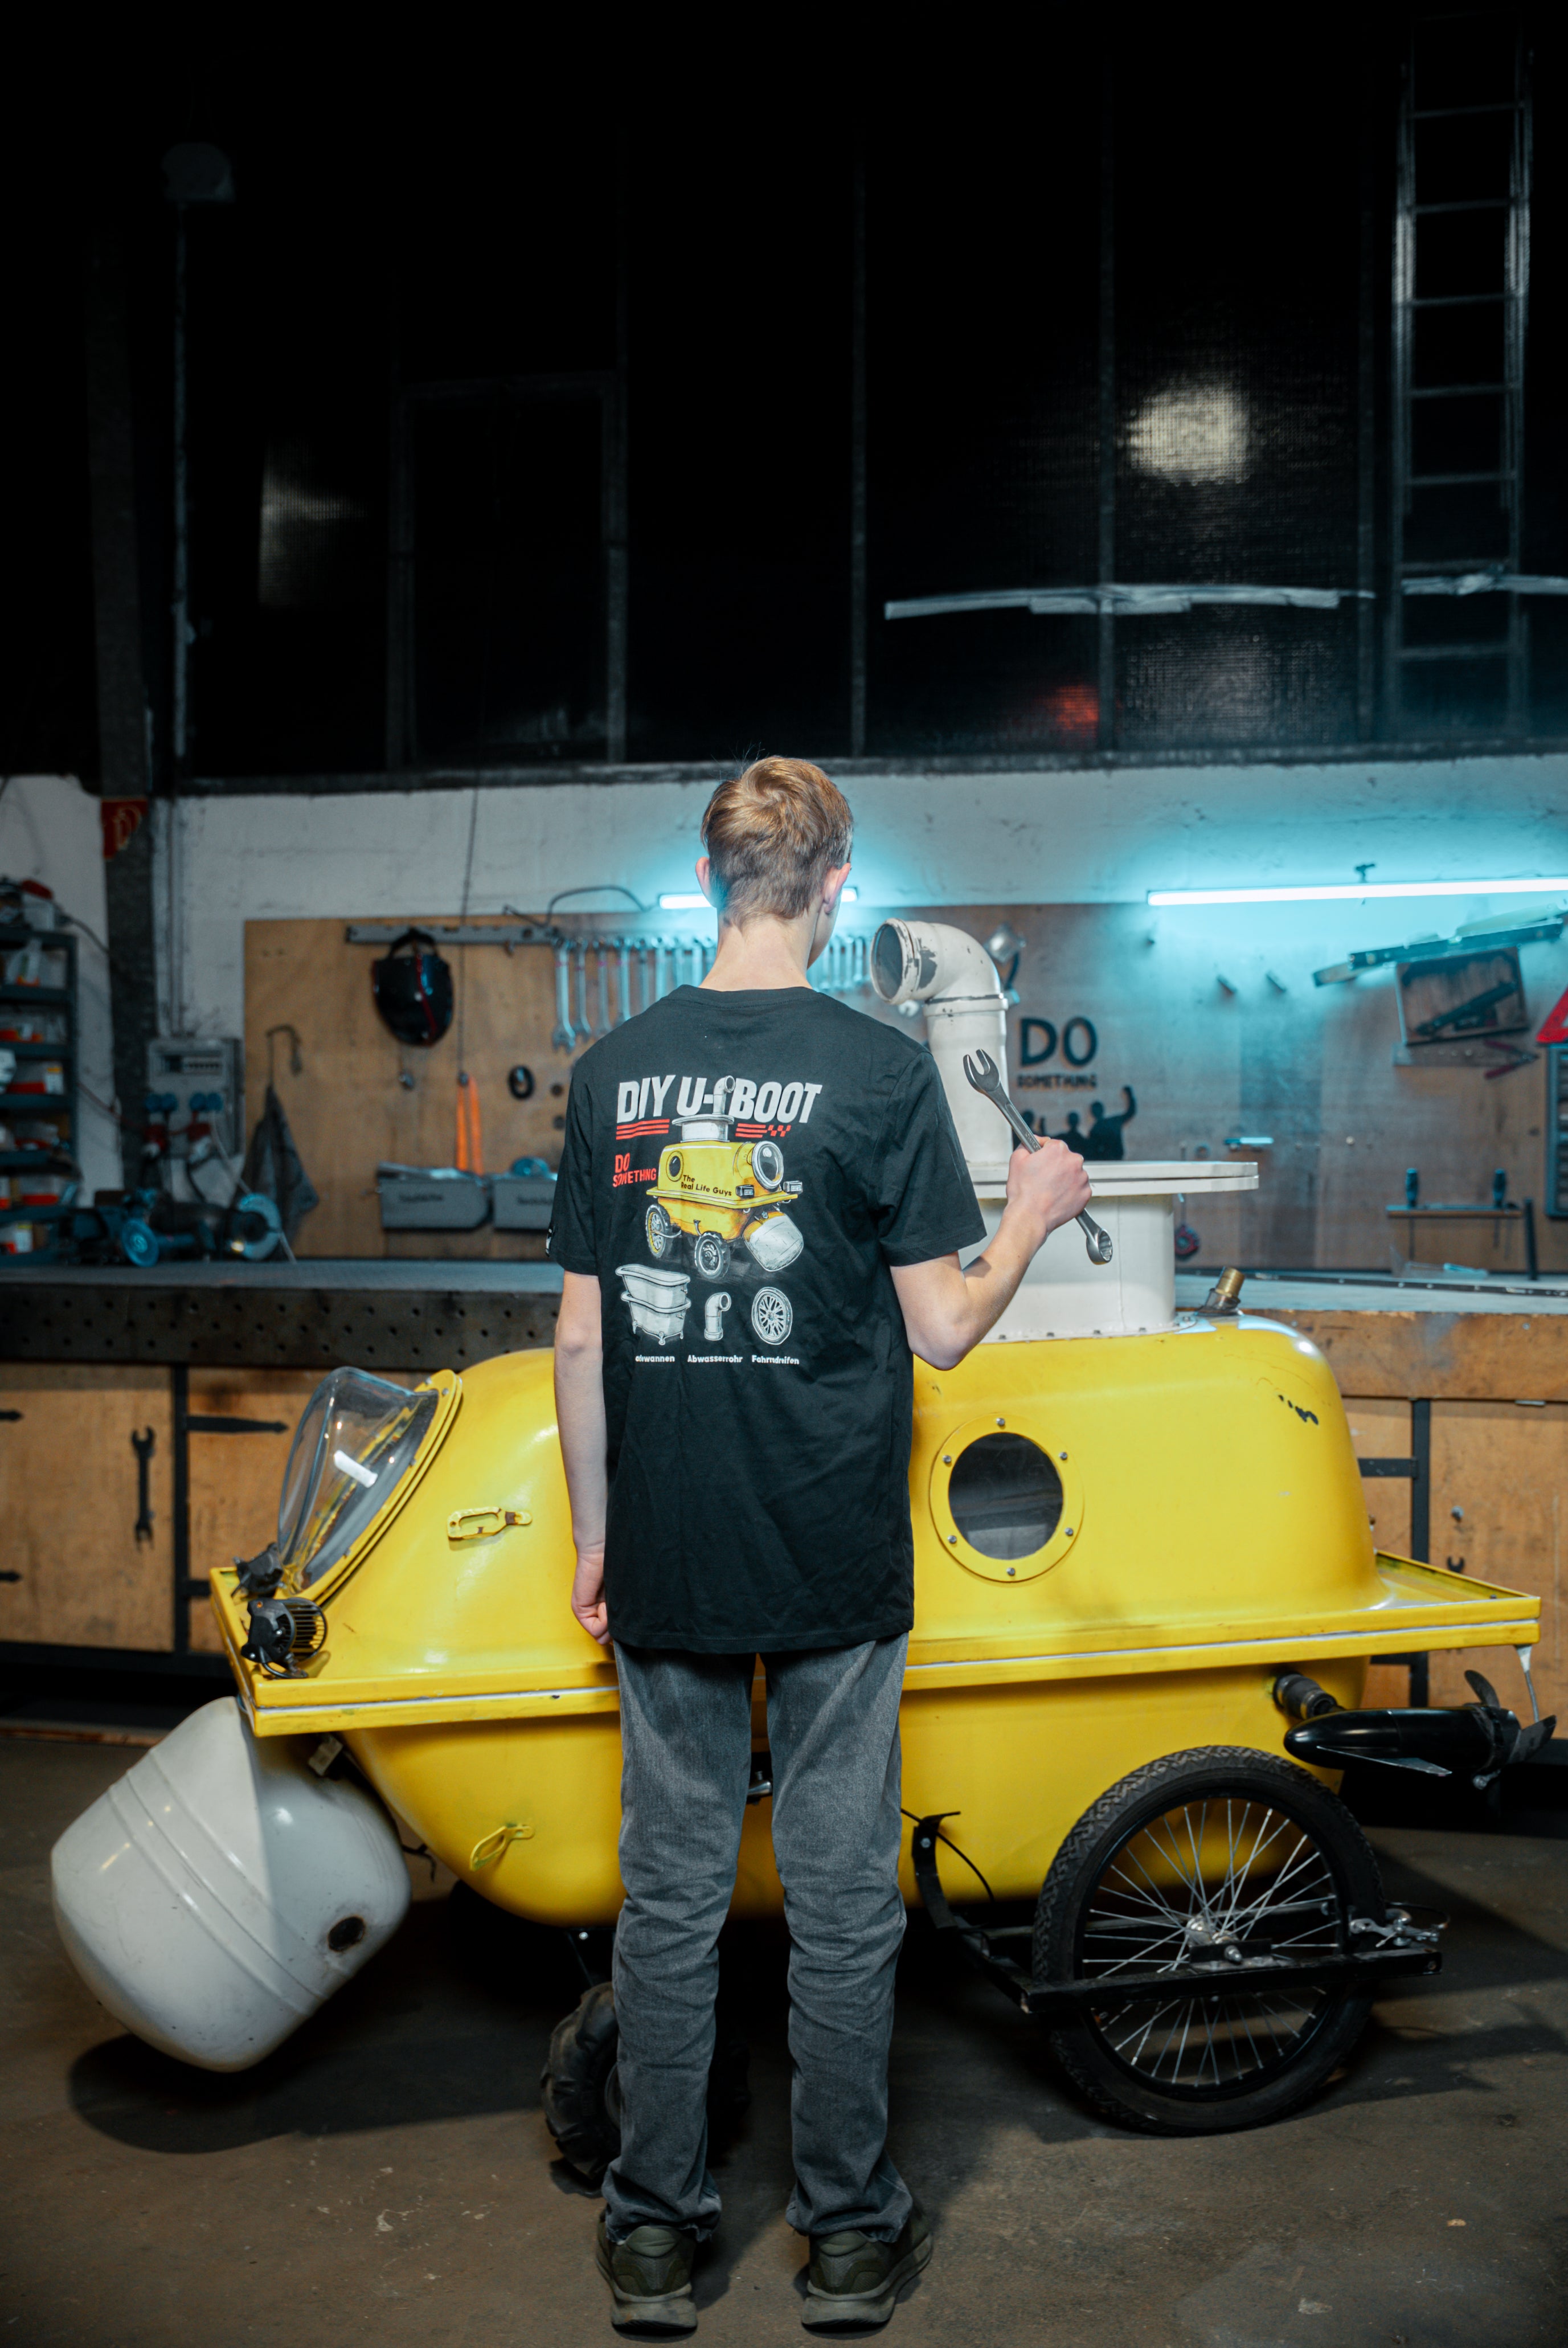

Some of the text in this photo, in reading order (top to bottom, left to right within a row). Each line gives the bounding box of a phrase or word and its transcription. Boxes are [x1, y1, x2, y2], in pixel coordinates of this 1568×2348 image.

[1019, 1017, 1098, 1067] DO
[616, 1074, 676, 1123] DIY
[615, 1152, 631, 1173] DO
[681, 1181, 732, 1196] Real Life Guys
[687, 1354, 743, 1363] Abwasserrohr
